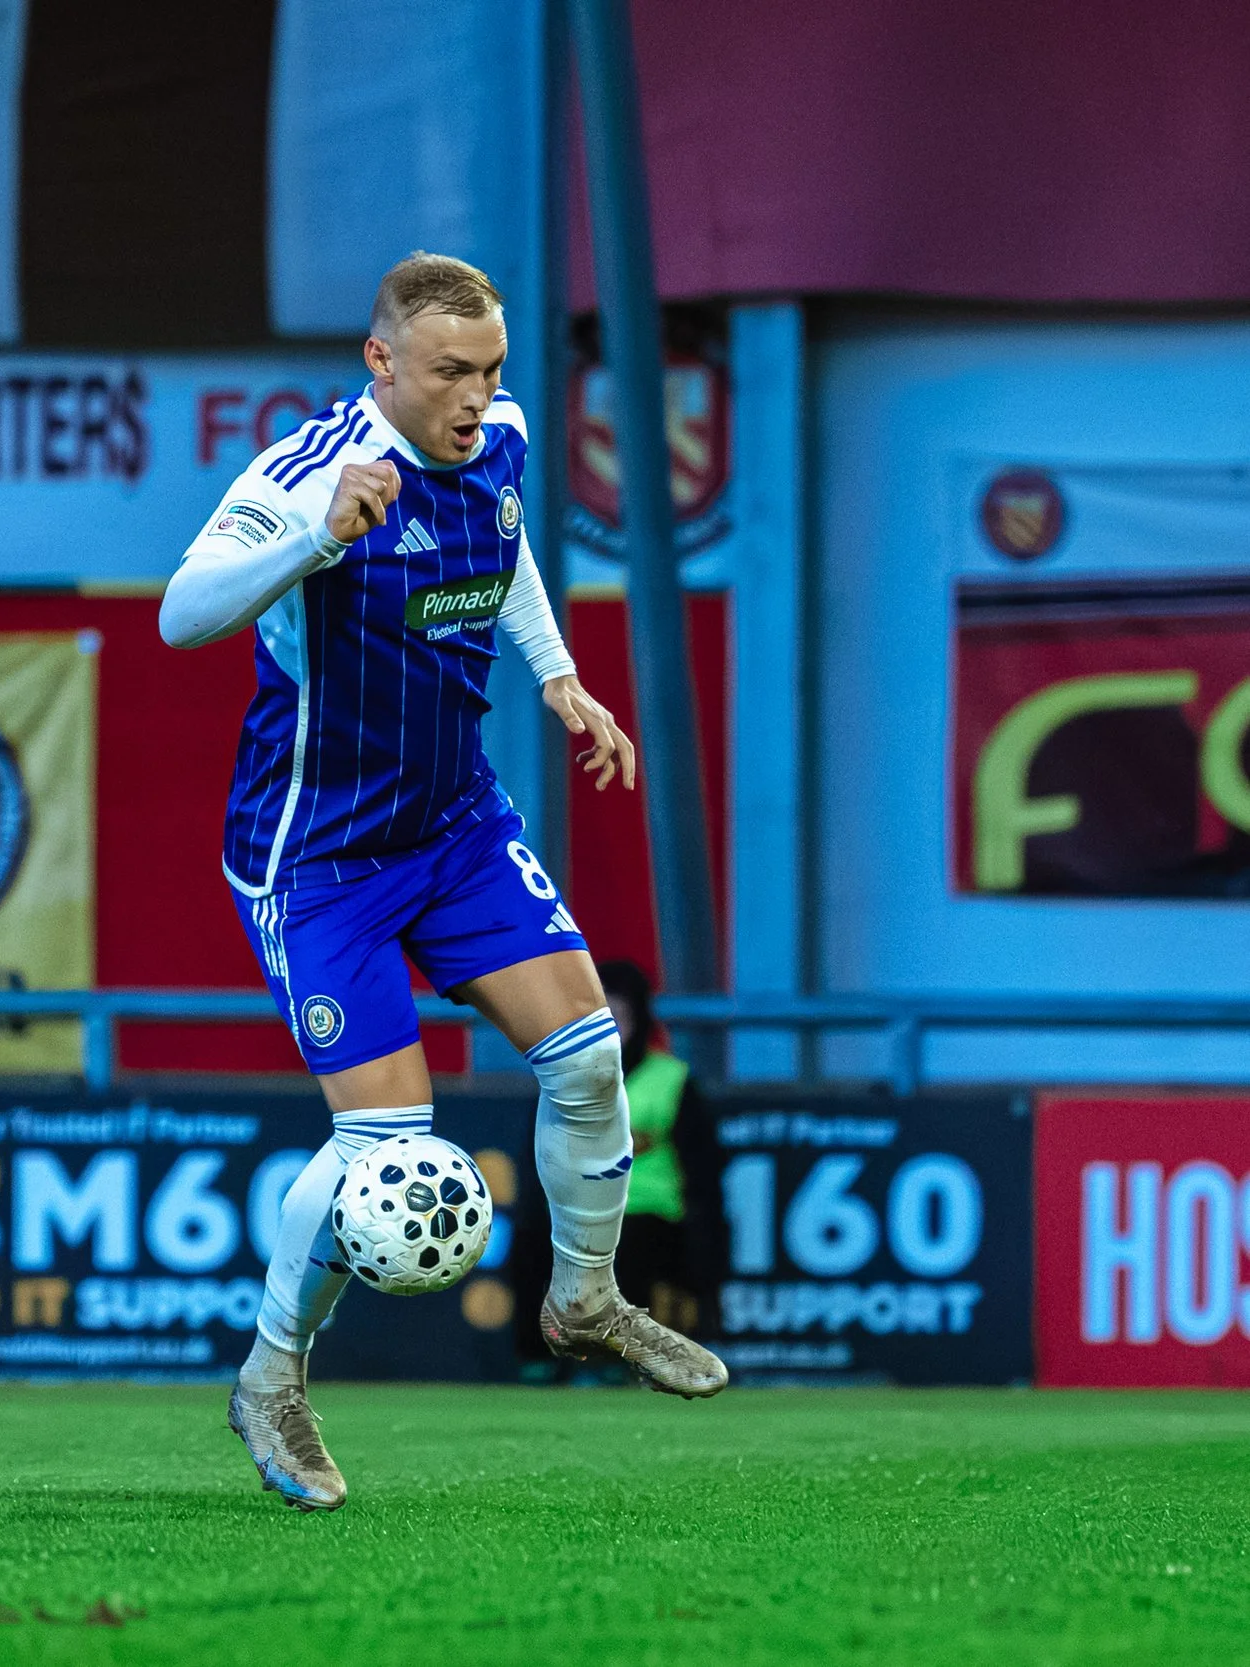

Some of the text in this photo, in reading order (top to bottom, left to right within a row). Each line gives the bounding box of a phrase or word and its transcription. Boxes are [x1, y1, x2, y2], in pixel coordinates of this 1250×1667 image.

[236, 520, 268, 543] NATIONAL
[423, 580, 504, 619] Pinnacle
[507, 840, 556, 900] 8
[1082, 1160, 1250, 1345] HO
[11, 1275, 263, 1331] IT SUPPO
[718, 1282, 982, 1335] SUPPORT
